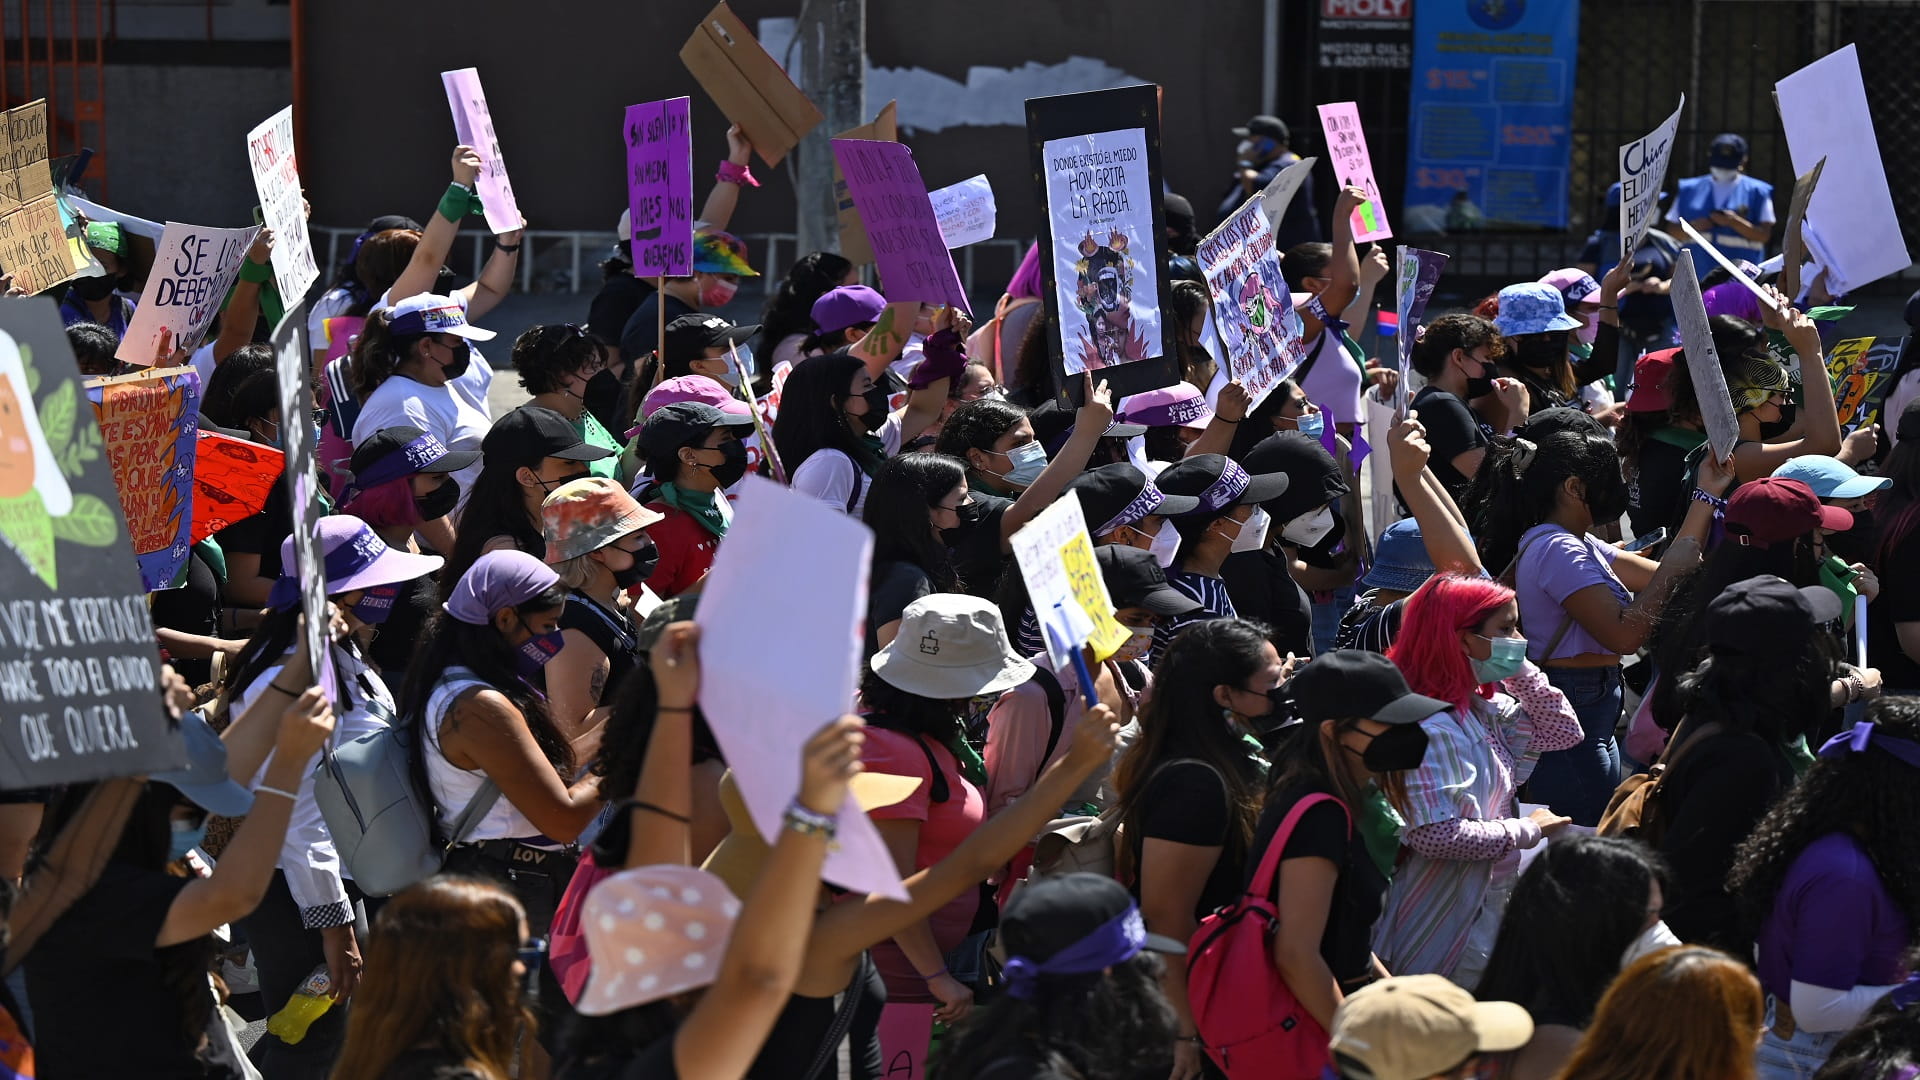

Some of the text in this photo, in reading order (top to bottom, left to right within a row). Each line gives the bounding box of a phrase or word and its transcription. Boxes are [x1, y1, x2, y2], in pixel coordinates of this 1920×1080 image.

[1053, 154, 1078, 172] DONDE
[1104, 151, 1113, 164] EL
[1113, 147, 1137, 164] MIEDO
[1623, 137, 1668, 176] Chivo
[1068, 165, 1126, 192] HOY GRITA
[1623, 179, 1640, 203] EL
[1071, 195, 1089, 219] LA
[174, 234, 210, 278] SE
[215, 237, 237, 273] LO
[110, 386, 167, 418] PORQUE
[128, 440, 161, 468] POR
[425, 433, 440, 447] JU
[127, 465, 162, 493] QUE
[1230, 467, 1249, 495] MAS
[20, 711, 59, 763] QUE
